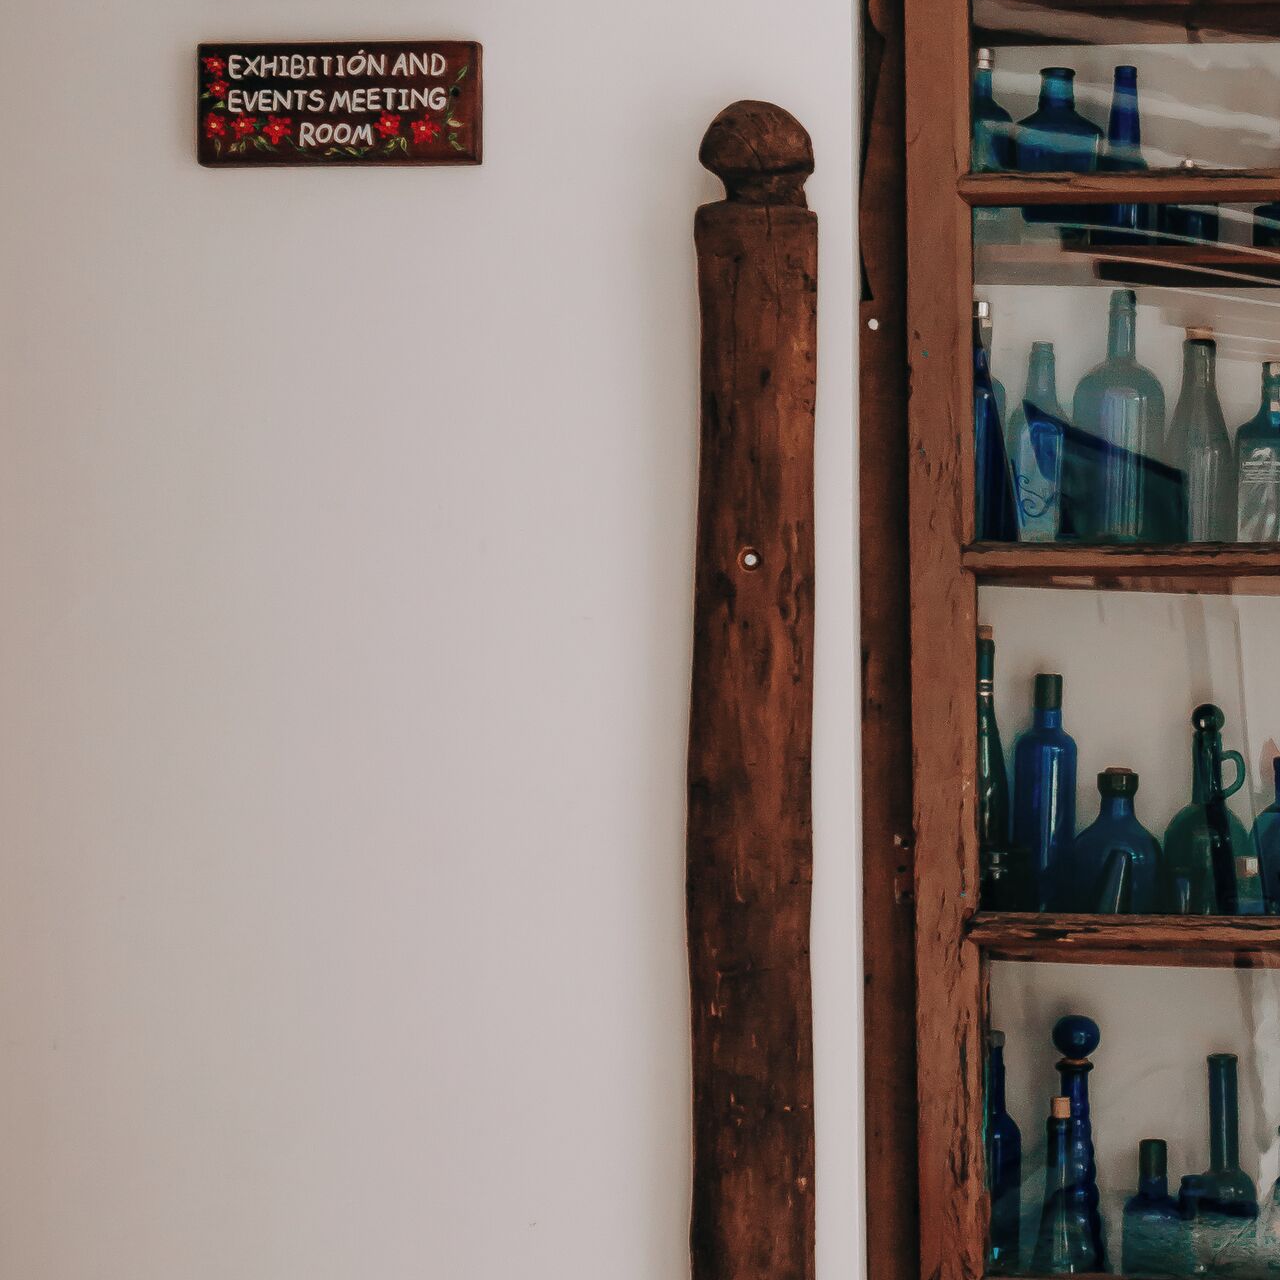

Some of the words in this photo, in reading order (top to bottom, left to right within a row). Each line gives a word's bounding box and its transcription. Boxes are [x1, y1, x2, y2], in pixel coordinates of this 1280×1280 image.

[228, 50, 385, 79] EXHIBITIÓN
[392, 53, 446, 77] AND
[228, 89, 324, 113] EVENTS
[329, 87, 447, 114] MEETING
[299, 123, 373, 147] ROOM
